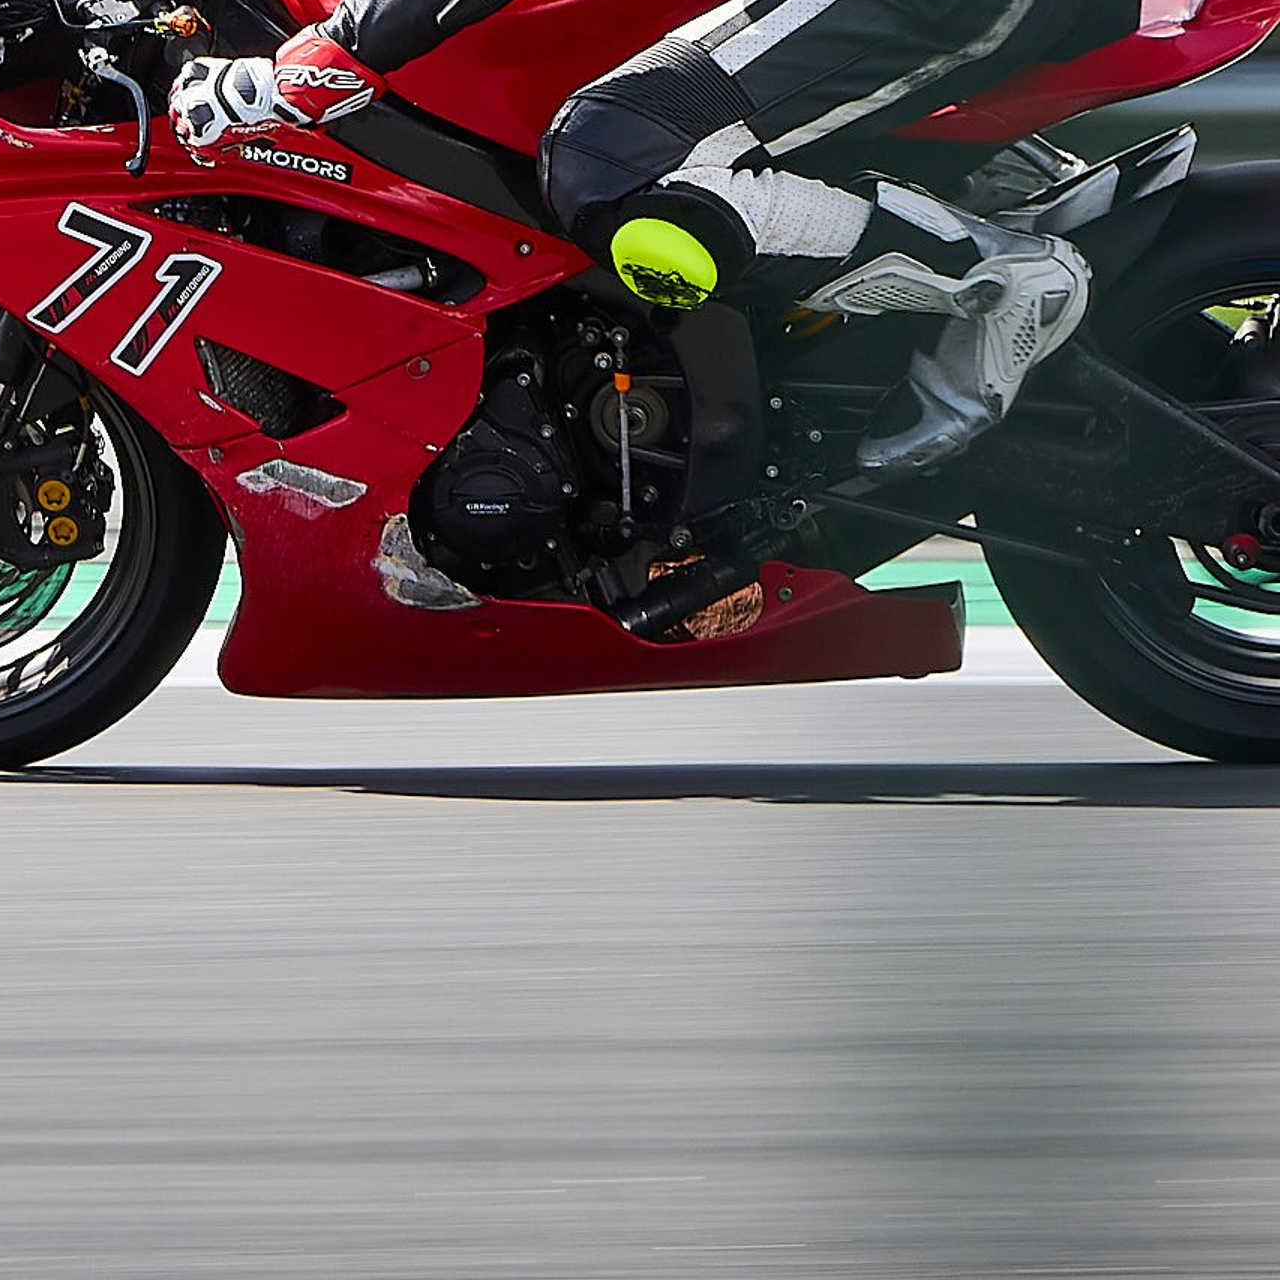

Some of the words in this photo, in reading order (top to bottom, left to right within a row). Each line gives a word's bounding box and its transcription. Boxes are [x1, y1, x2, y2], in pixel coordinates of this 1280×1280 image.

[94, 239, 132, 277] MOTORING
[26, 201, 223, 377] 71
[176, 264, 211, 306] MOTORING
